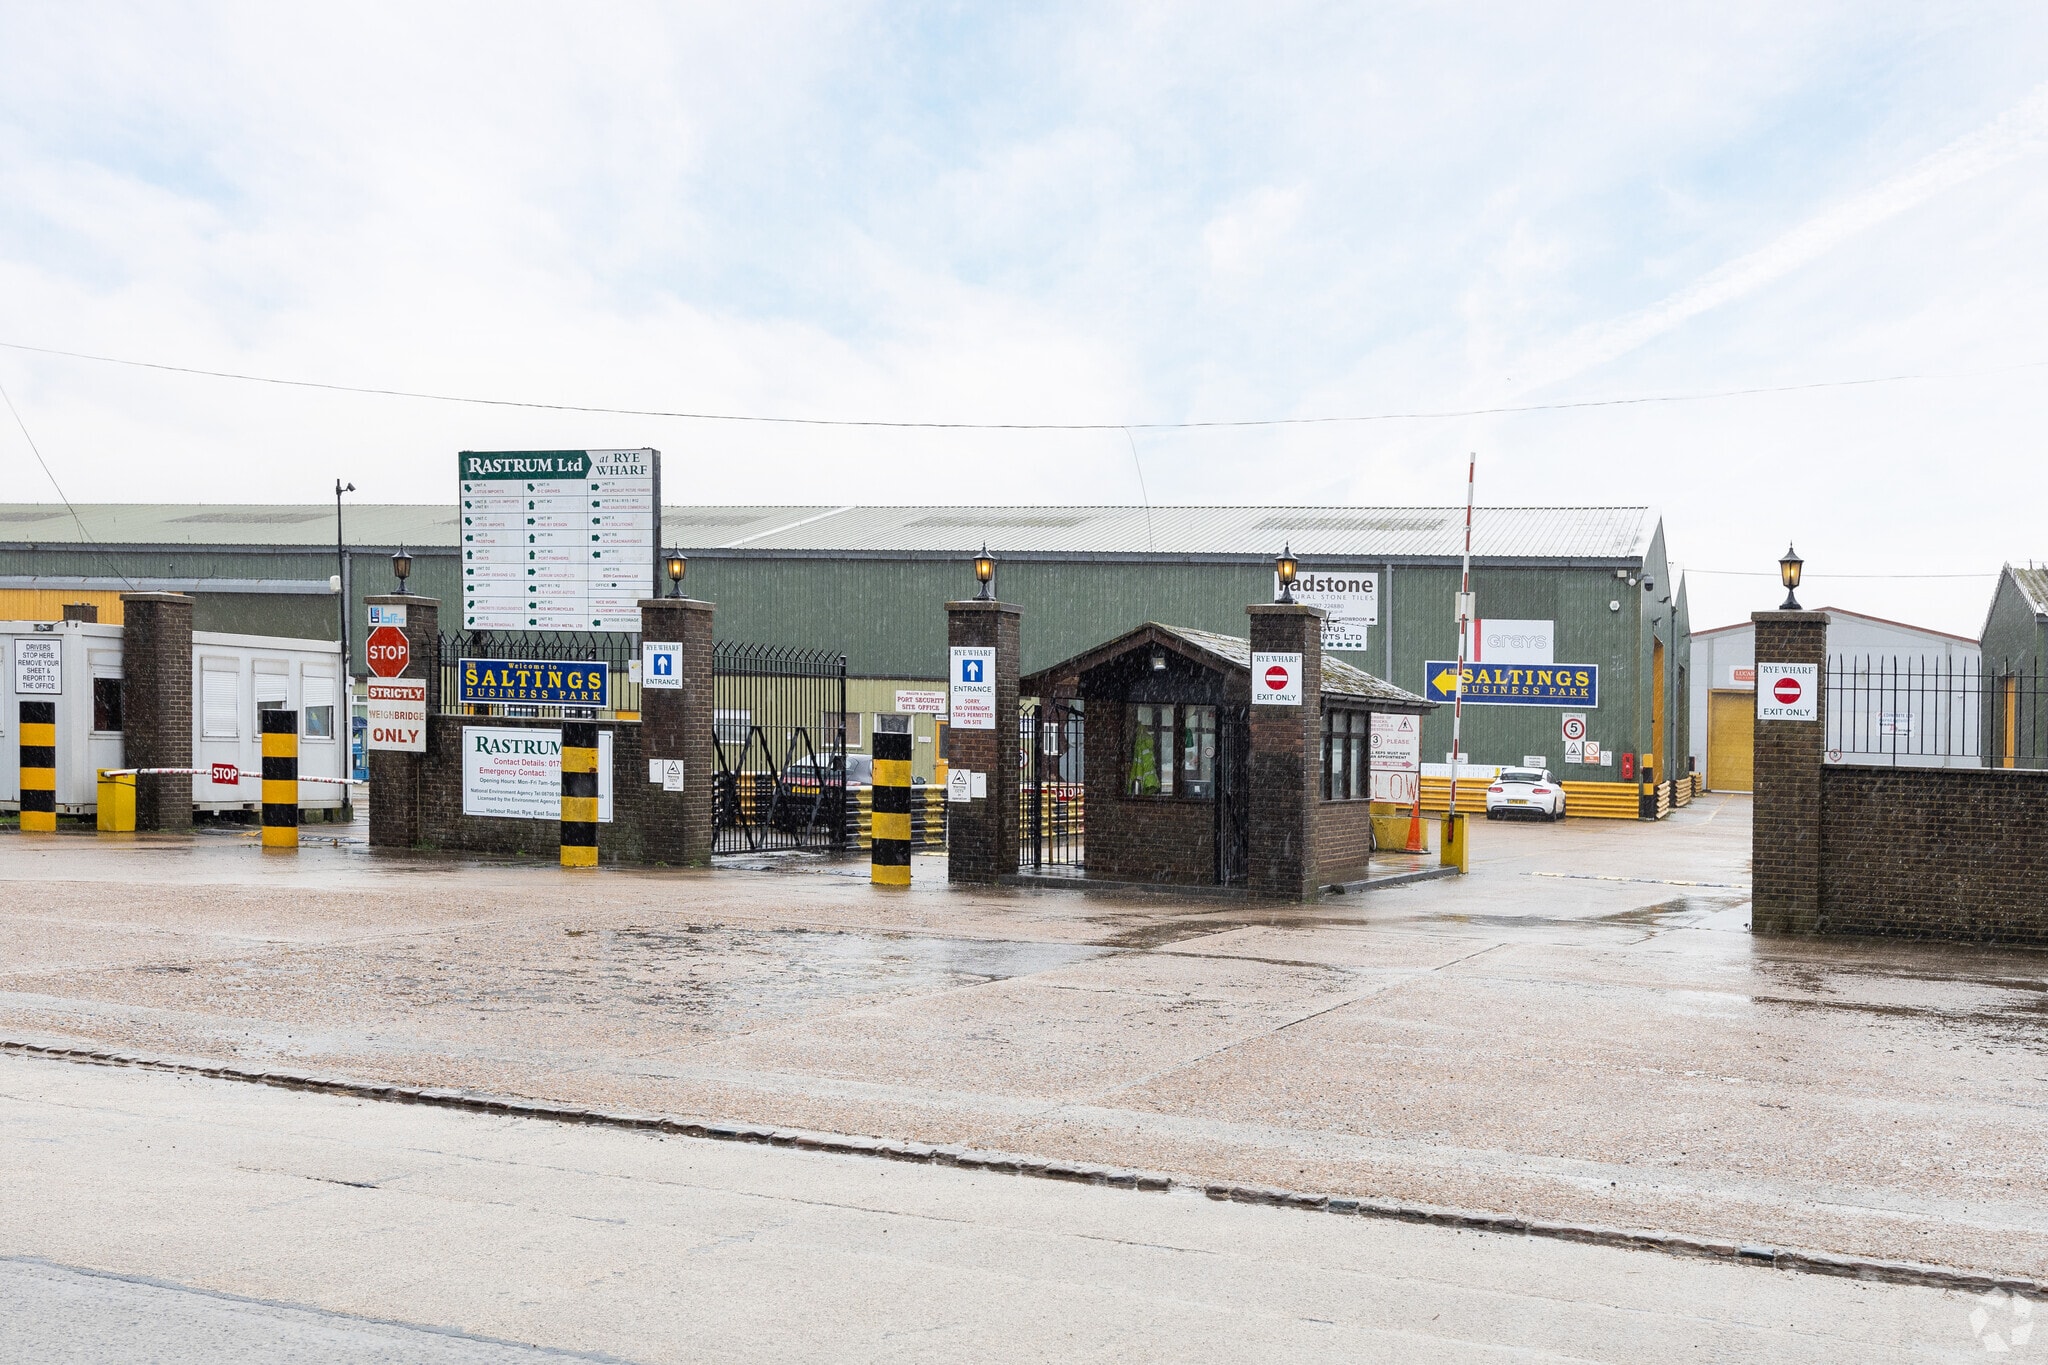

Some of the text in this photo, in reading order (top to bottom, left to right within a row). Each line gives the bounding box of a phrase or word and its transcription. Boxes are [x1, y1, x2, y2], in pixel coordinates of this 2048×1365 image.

[599, 453, 640, 463] at RYE
[468, 458, 583, 474] RASTRUM Ltd
[596, 465, 648, 475] WHARF
[1279, 575, 1373, 593] adstone
[369, 646, 406, 660] STOP
[1763, 666, 1813, 674] RYE WHARF
[466, 669, 601, 689] SALTINGS
[1461, 669, 1590, 687] SALTINGS
[370, 688, 422, 699] STRICTLY
[466, 687, 601, 700] BUSINESS PARK
[953, 685, 992, 693] ENTRANCE
[1461, 686, 1589, 696] BUSINESS PARK
[369, 710, 424, 721] WEIGHBRIDGE
[1570, 723, 1578, 733] 5
[373, 728, 419, 743] ONLY
[494, 757, 520, 766] Contact
[522, 759, 547, 767] Details:
[213, 767, 237, 780] STOP
[479, 767, 516, 777] Emergency
[518, 768, 547, 777] Contact:
[480, 777, 499, 785] Opening
[1375, 774, 1418, 801] LOW
